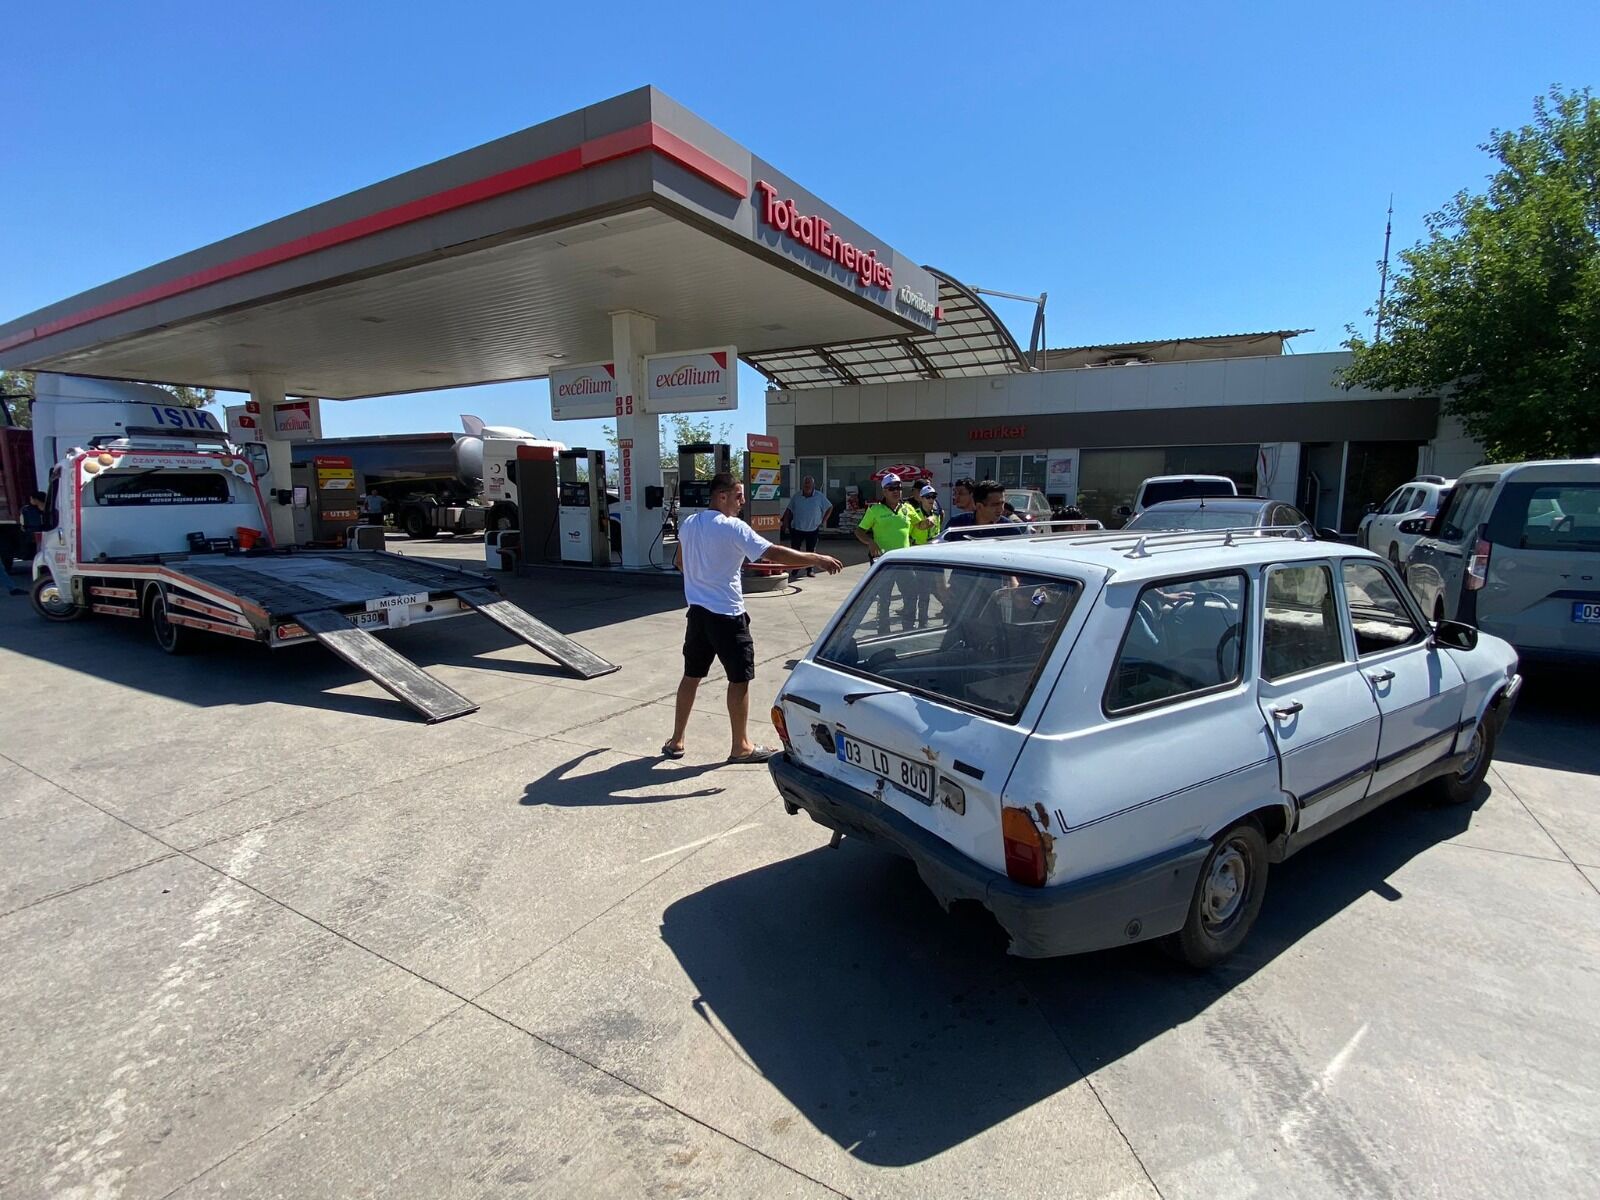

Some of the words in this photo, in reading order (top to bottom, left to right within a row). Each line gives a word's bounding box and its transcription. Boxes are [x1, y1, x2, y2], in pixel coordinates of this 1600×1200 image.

[756, 179, 894, 291] TotalEnergies
[656, 368, 720, 388] excellium
[559, 379, 612, 397] excellium
[968, 424, 1026, 440] market
[758, 516, 774, 526] UTTS
[361, 613, 377, 623] 530
[1584, 606, 1600, 618] 09
[845, 740, 861, 763] 03
[872, 749, 889, 775] LD
[901, 761, 928, 793] 800
